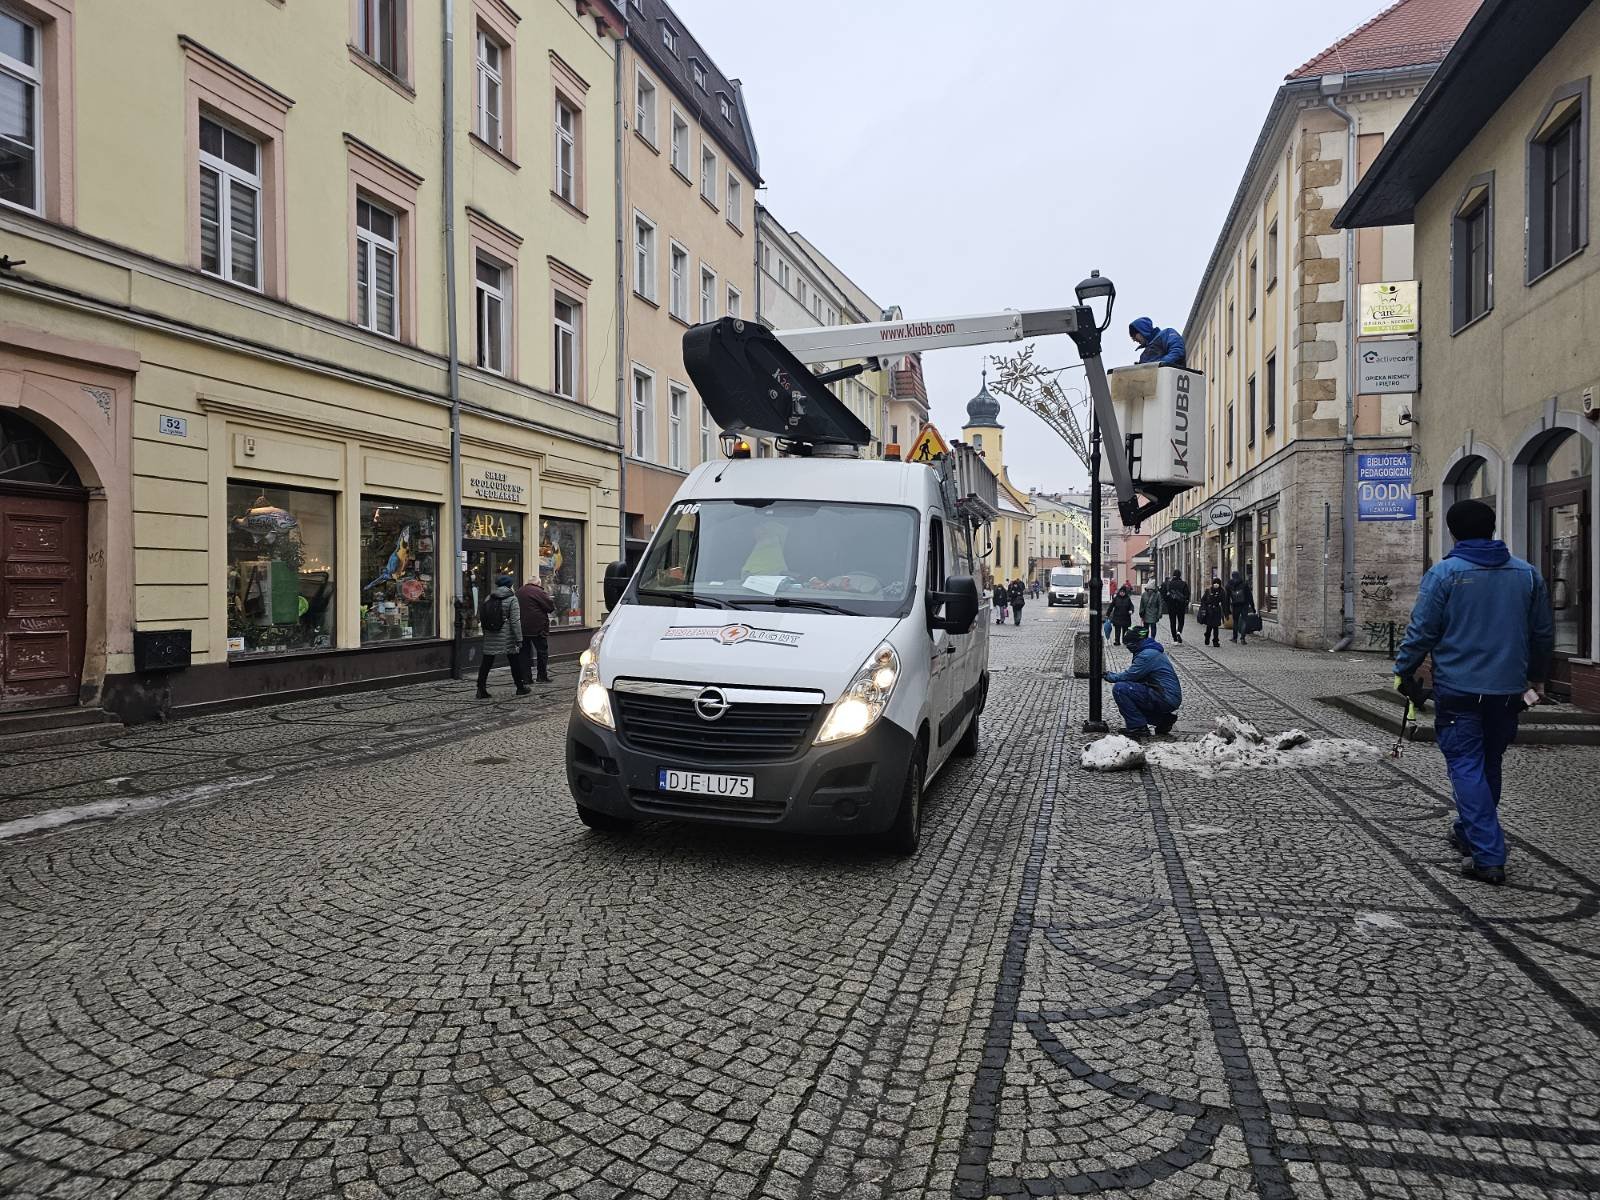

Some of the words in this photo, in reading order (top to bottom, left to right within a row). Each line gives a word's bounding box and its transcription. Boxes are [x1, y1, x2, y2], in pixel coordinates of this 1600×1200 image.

[880, 322, 956, 340] www.klubb.com
[166, 418, 181, 430] 52
[1170, 374, 1190, 474] KLUBB
[1367, 457, 1407, 467] BIBLIOTEKA
[1362, 483, 1412, 500] DODN
[474, 513, 507, 538] ARA
[669, 772, 701, 792] DJE
[706, 775, 749, 796] LU75
